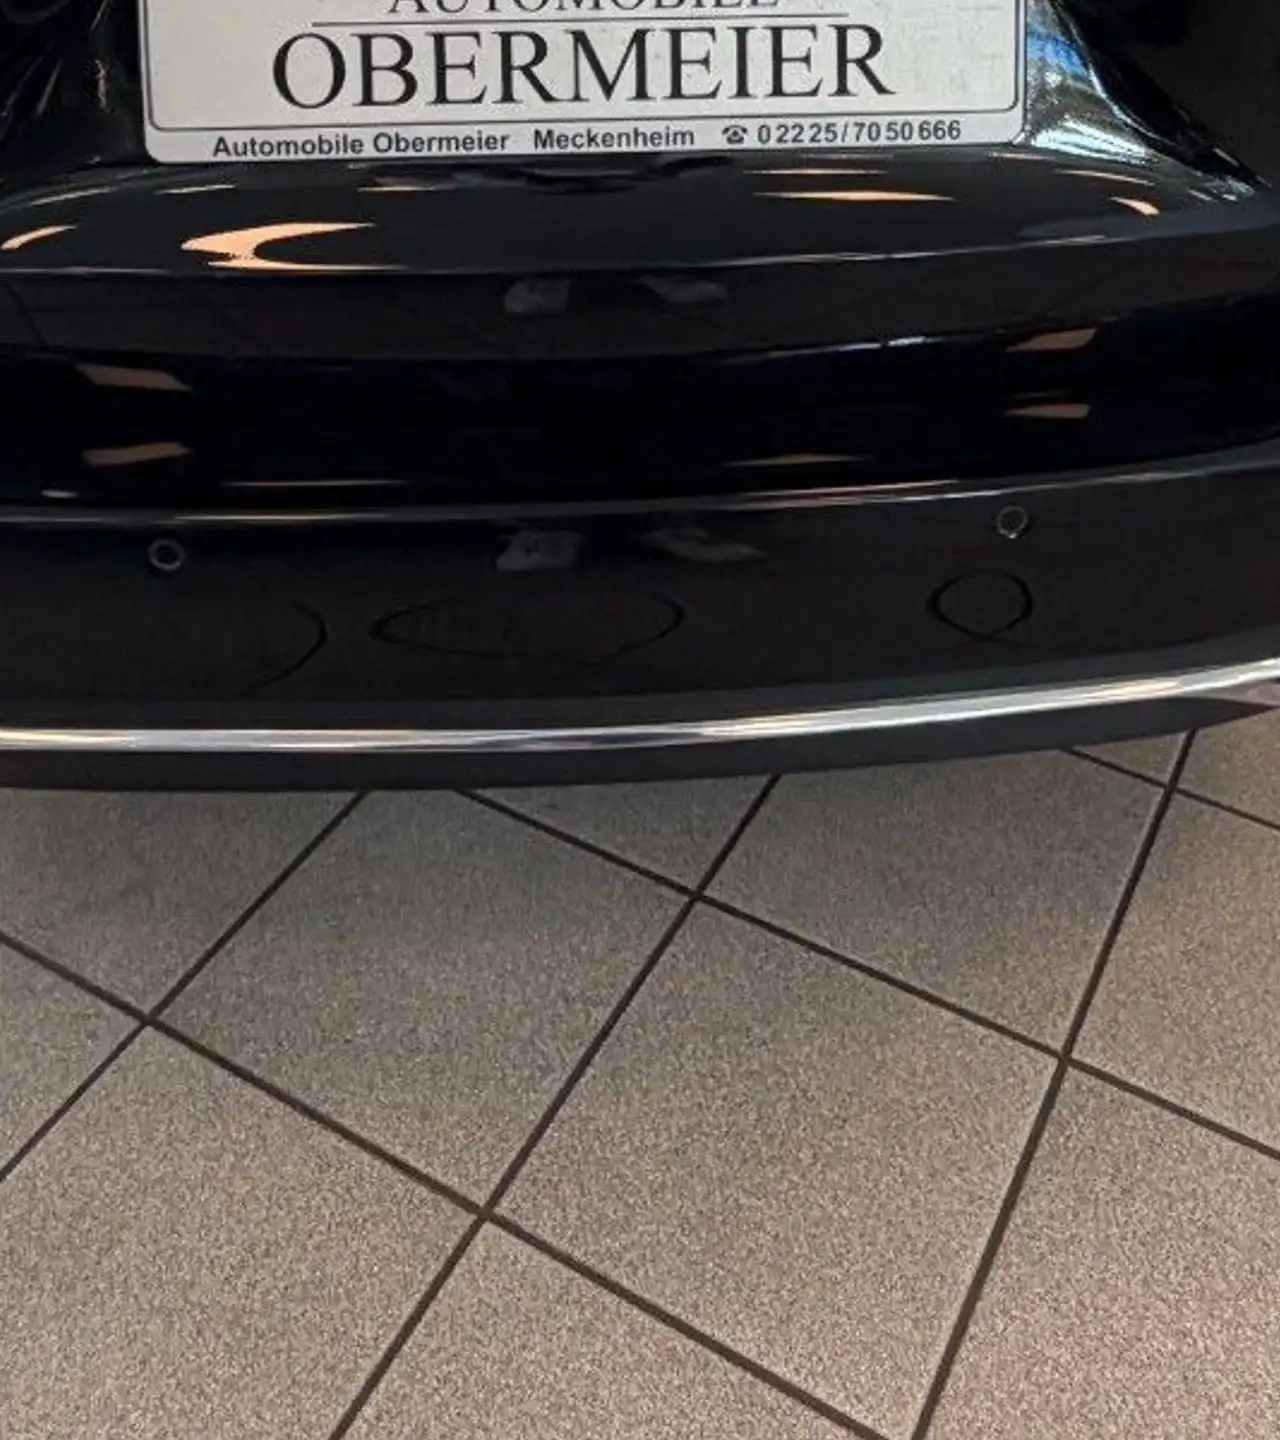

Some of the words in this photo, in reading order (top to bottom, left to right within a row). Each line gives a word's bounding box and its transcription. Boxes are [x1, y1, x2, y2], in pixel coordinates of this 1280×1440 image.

[272, 23, 895, 109] OBERMEIER
[212, 133, 364, 158] Automobile
[372, 131, 510, 154] Obermeier
[533, 125, 695, 150] Meckenheim
